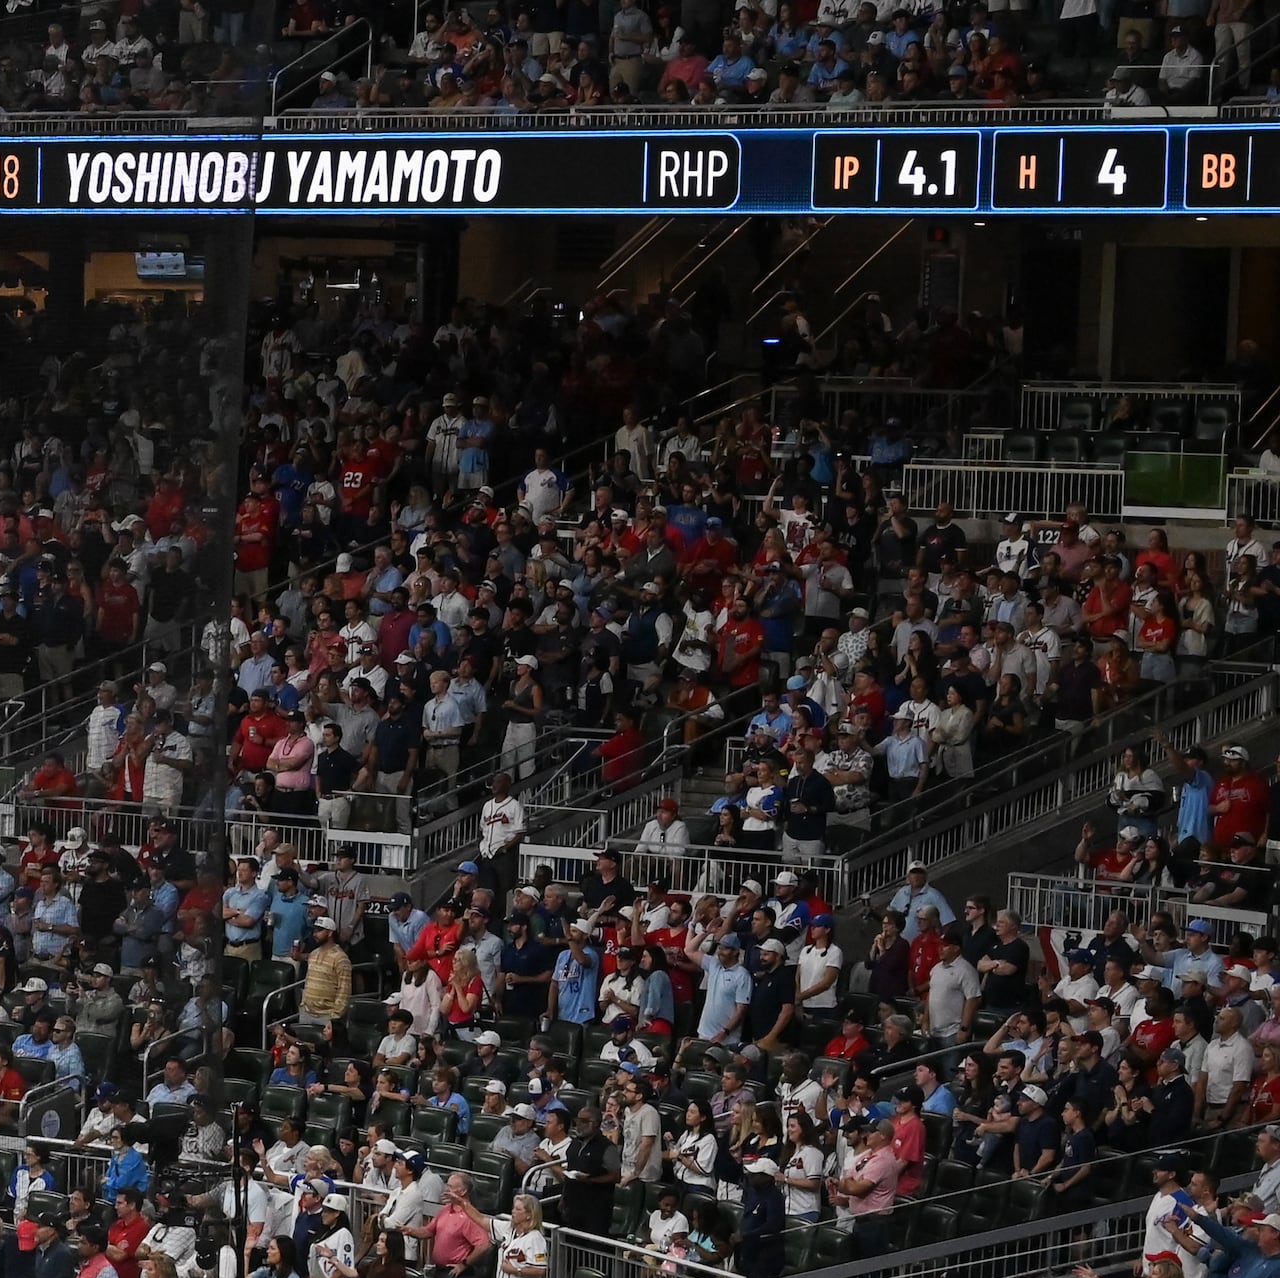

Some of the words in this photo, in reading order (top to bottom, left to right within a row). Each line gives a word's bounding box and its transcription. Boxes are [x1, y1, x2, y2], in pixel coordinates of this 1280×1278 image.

[288, 149, 502, 203] YAMAMOTO
[659, 151, 729, 197] RHP
[834, 156, 859, 190] IP
[898, 150, 956, 196] 4.1
[1019, 155, 1036, 189] H
[1097, 148, 1126, 195] 4
[1201, 153, 1236, 189] BB
[343, 471, 363, 488] 23
